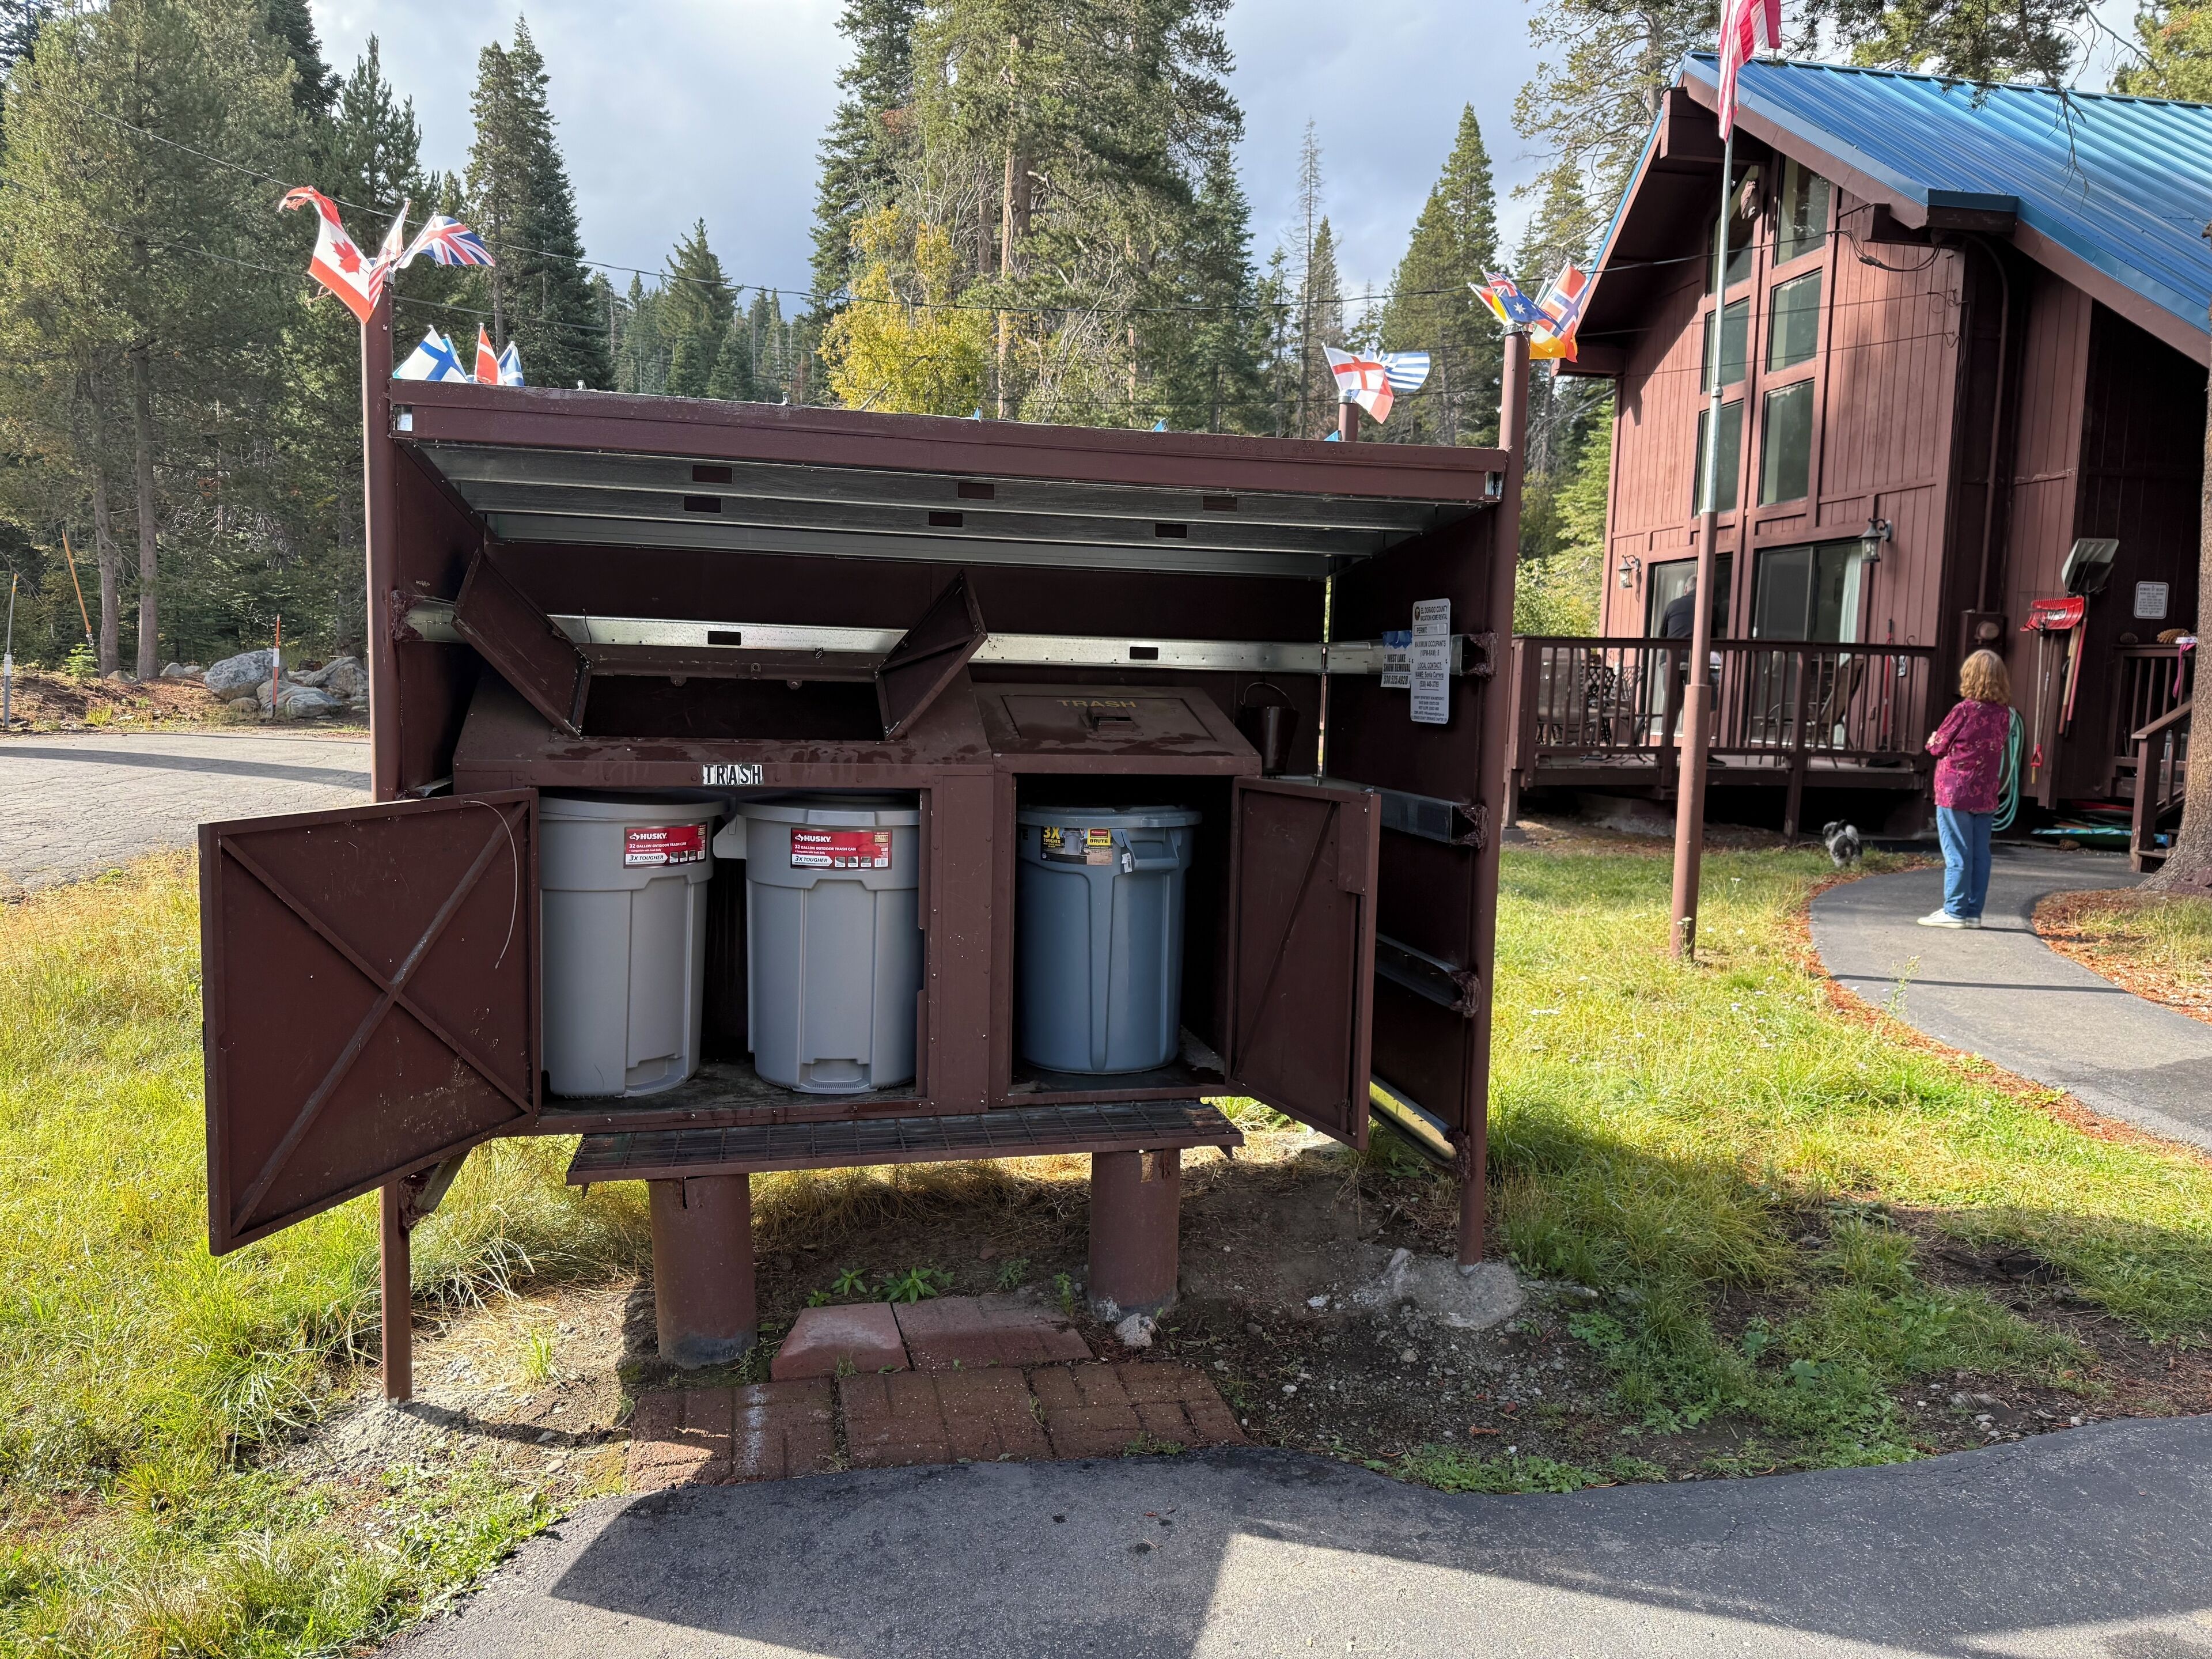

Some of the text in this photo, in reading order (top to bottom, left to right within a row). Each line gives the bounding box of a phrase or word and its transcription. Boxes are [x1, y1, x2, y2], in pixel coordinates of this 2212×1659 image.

[1387, 654, 1406, 662] WEST LAKE
[1383, 663, 1411, 672] SNOW REMOVAL
[704, 765, 761, 785] TRASH
